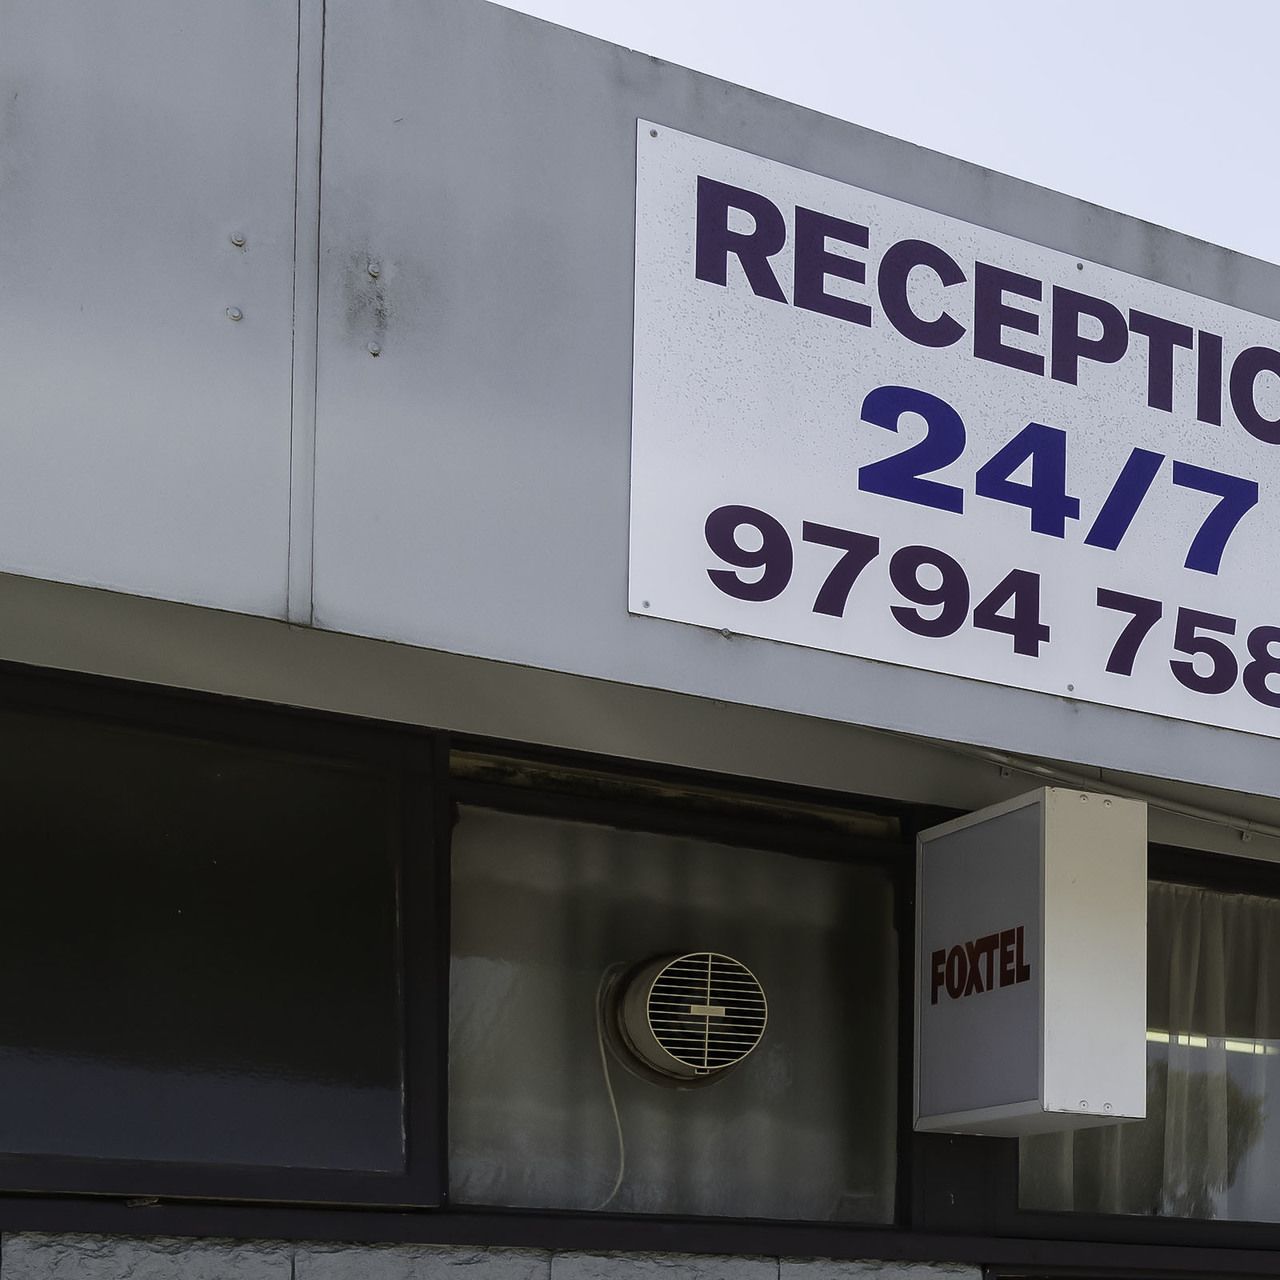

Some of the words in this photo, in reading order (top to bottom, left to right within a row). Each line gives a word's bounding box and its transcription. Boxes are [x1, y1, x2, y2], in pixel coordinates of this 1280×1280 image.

[857, 384, 1260, 576] 24/7
[702, 503, 1051, 659] 9794
[930, 925, 1031, 1006] FOXTEL
